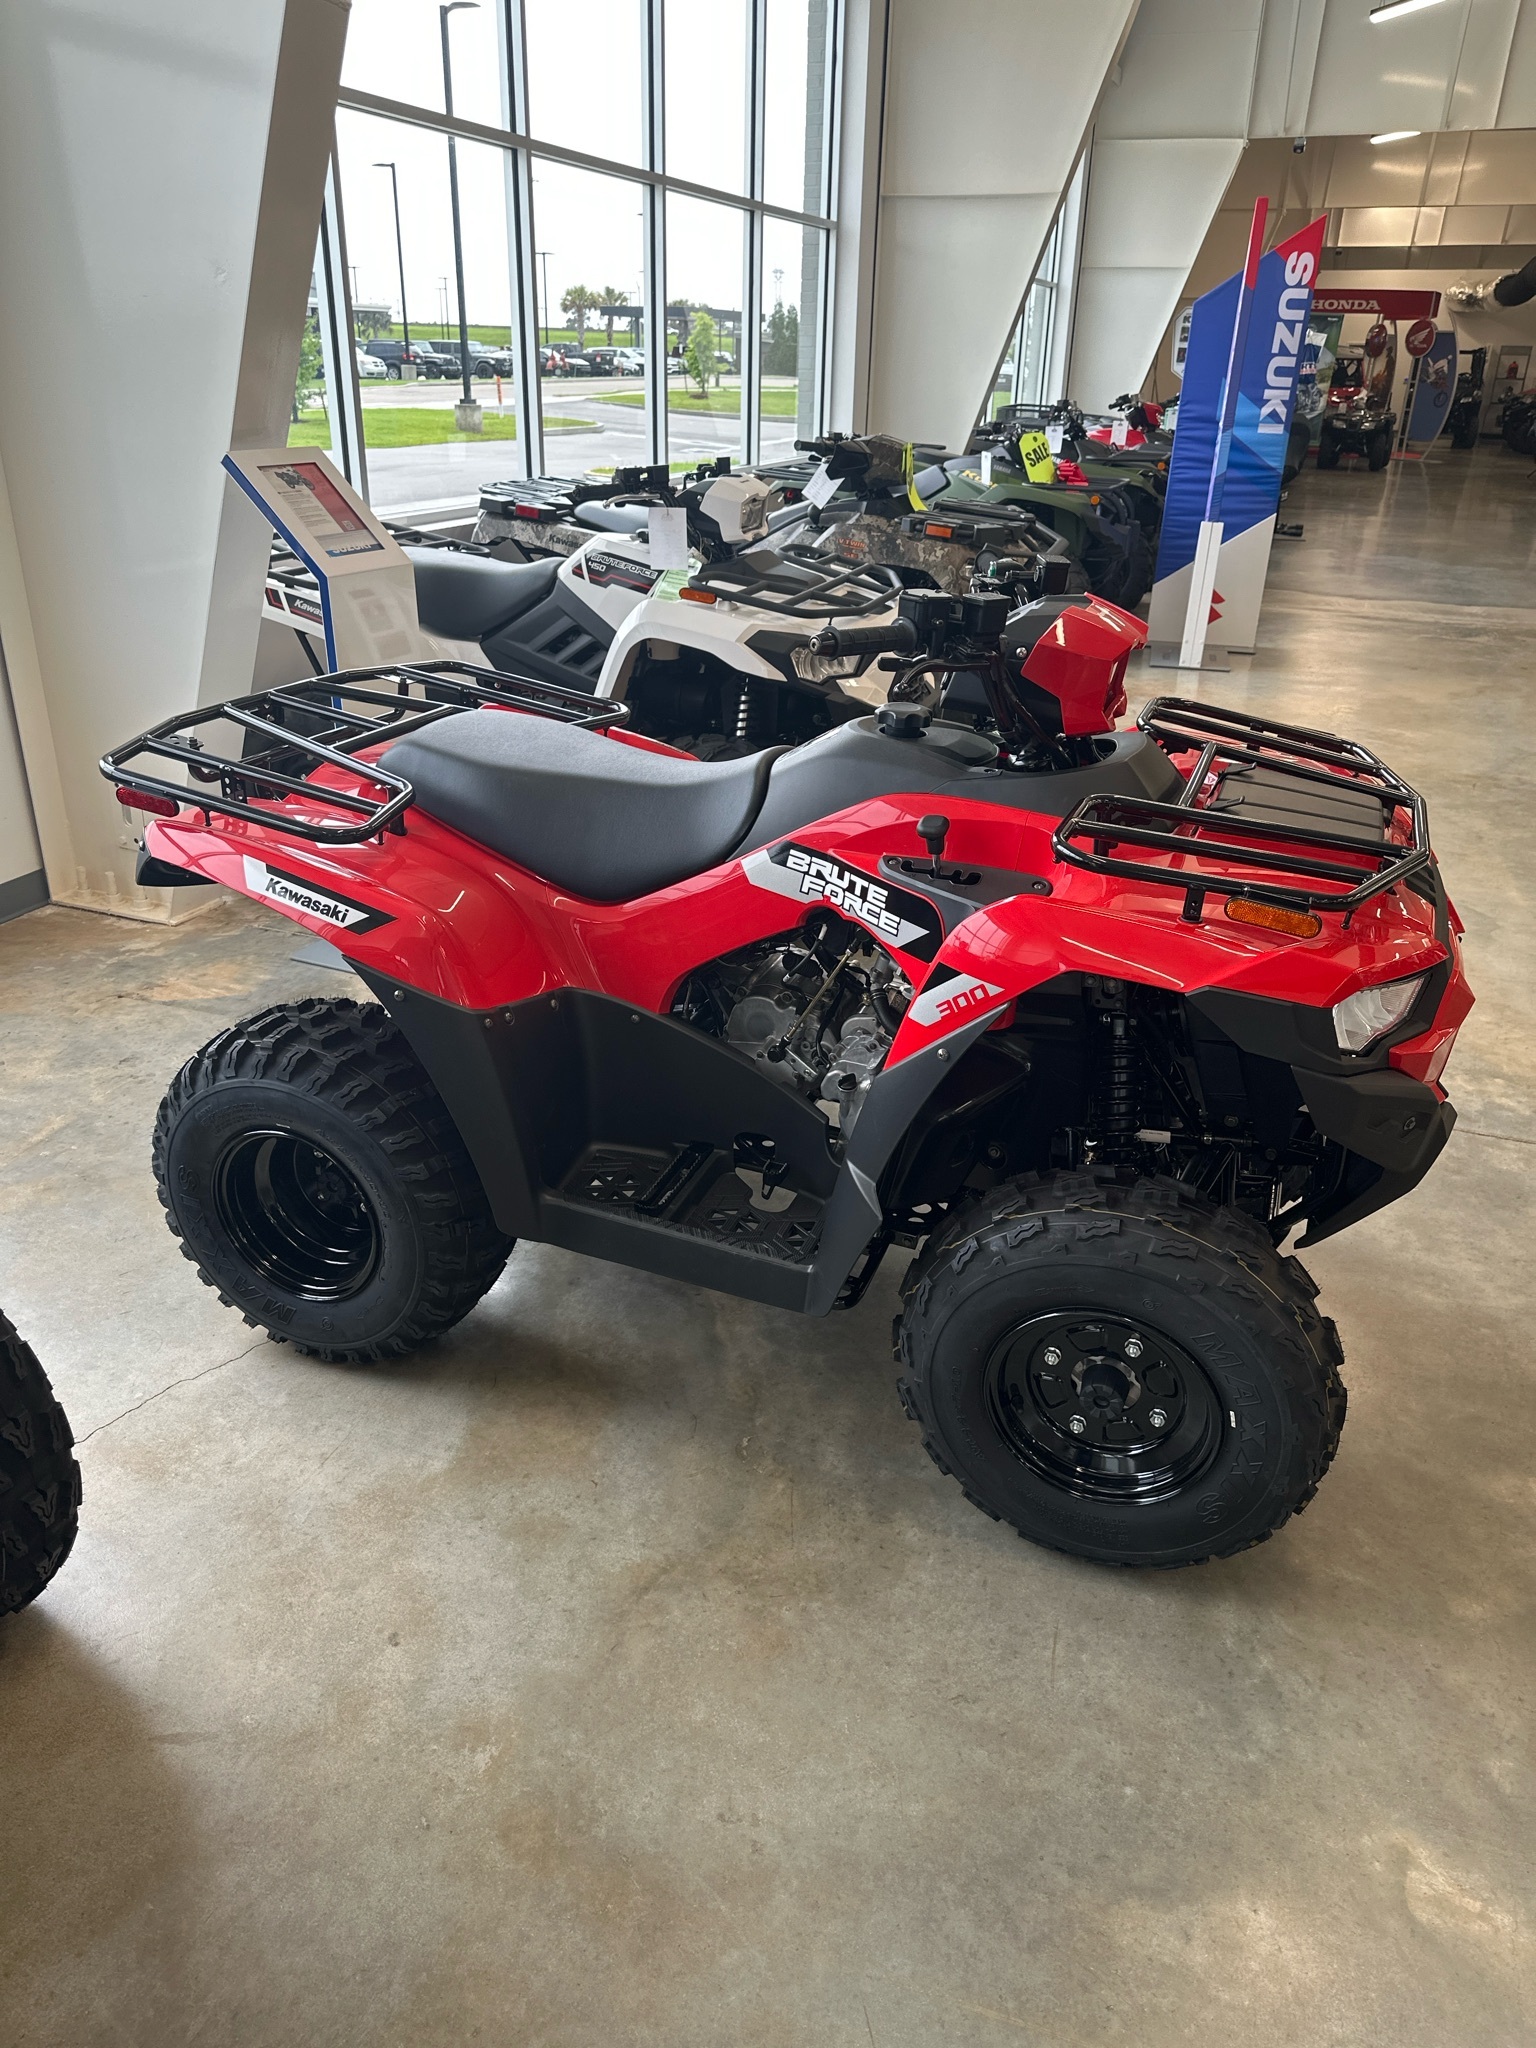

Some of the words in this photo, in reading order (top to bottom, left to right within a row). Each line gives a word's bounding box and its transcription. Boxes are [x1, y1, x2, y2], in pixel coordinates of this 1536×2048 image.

[1311, 299, 1381, 311] HONDA
[1257, 250, 1315, 434] SUZUKI
[1024, 442, 1050, 468] SALE
[587, 561, 606, 572] 450
[265, 877, 350, 924] Kawasaki
[785, 848, 890, 910] BRUTE
[800, 873, 903, 937] FORCE
[935, 983, 990, 1018] 300
[177, 1164, 297, 1325] MAXXIS
[1190, 1331, 1268, 1524] MAXXIS
